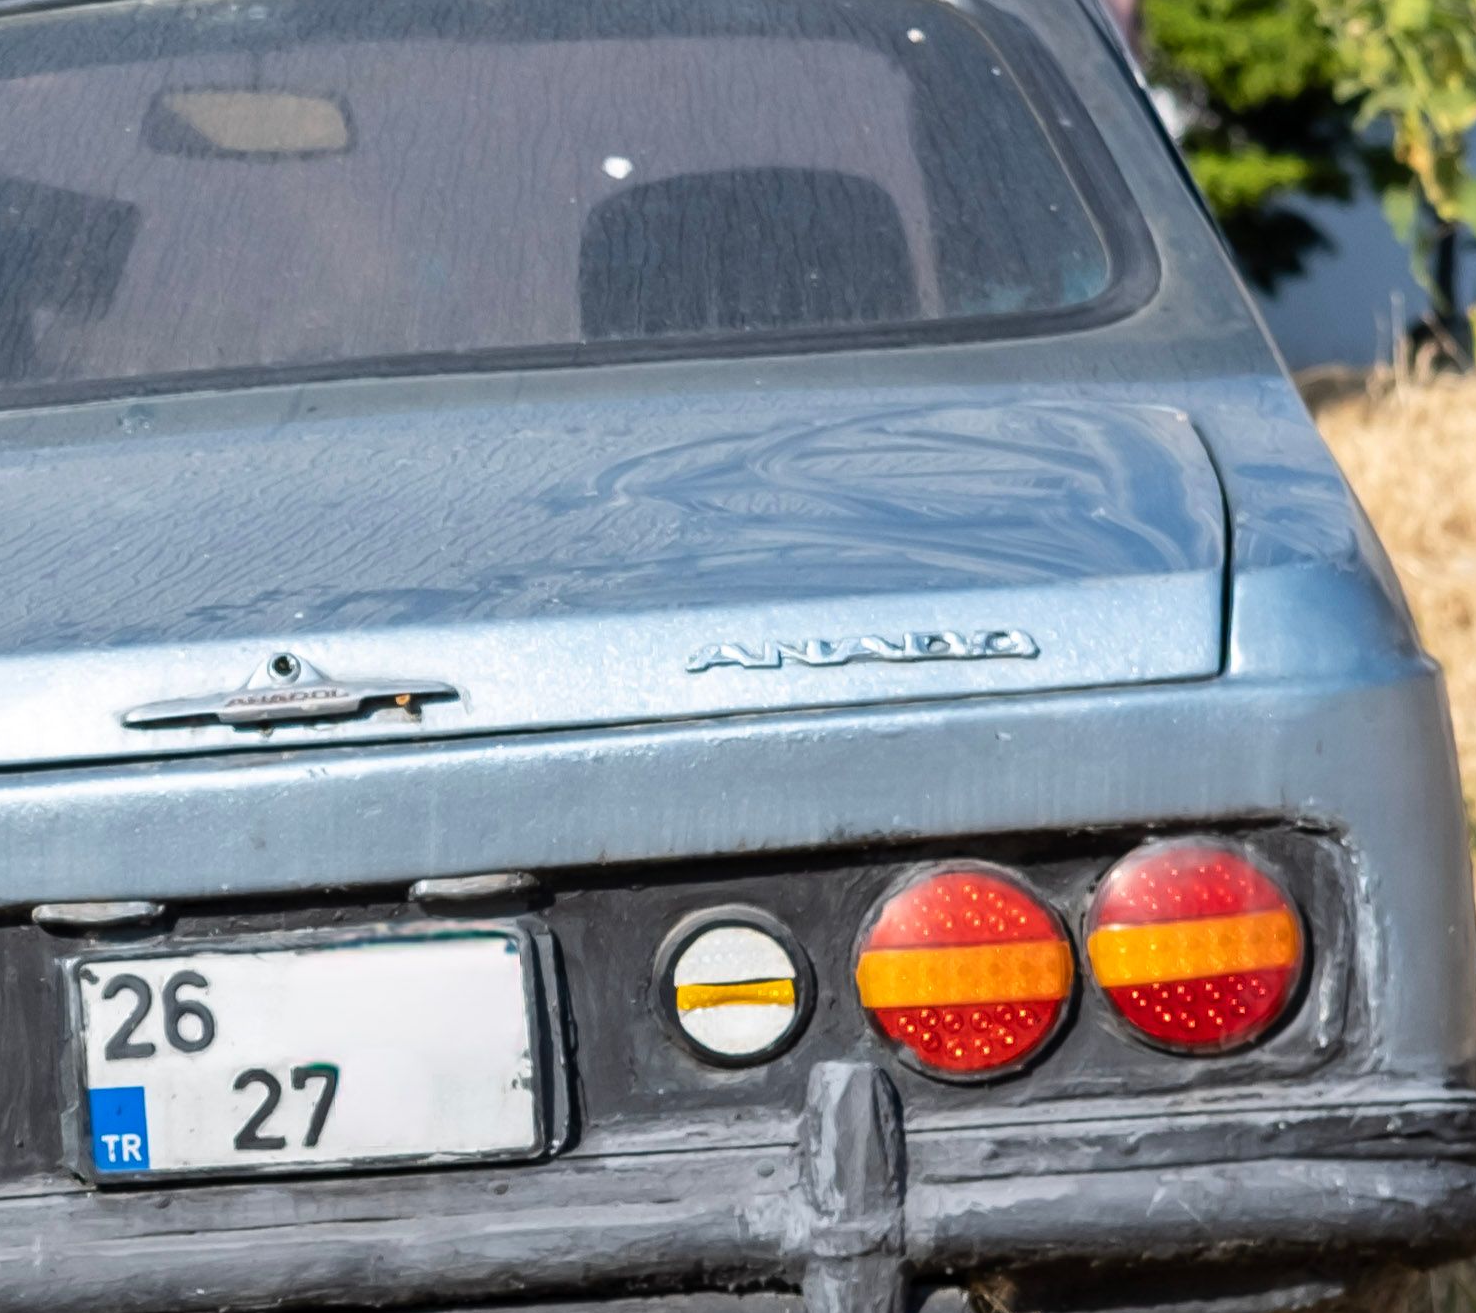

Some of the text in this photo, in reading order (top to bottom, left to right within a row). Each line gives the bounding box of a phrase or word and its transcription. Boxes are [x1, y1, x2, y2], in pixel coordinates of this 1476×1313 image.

[102, 969, 216, 1061] 26
[100, 1133, 143, 1163] TR
[232, 1062, 340, 1151] 27
